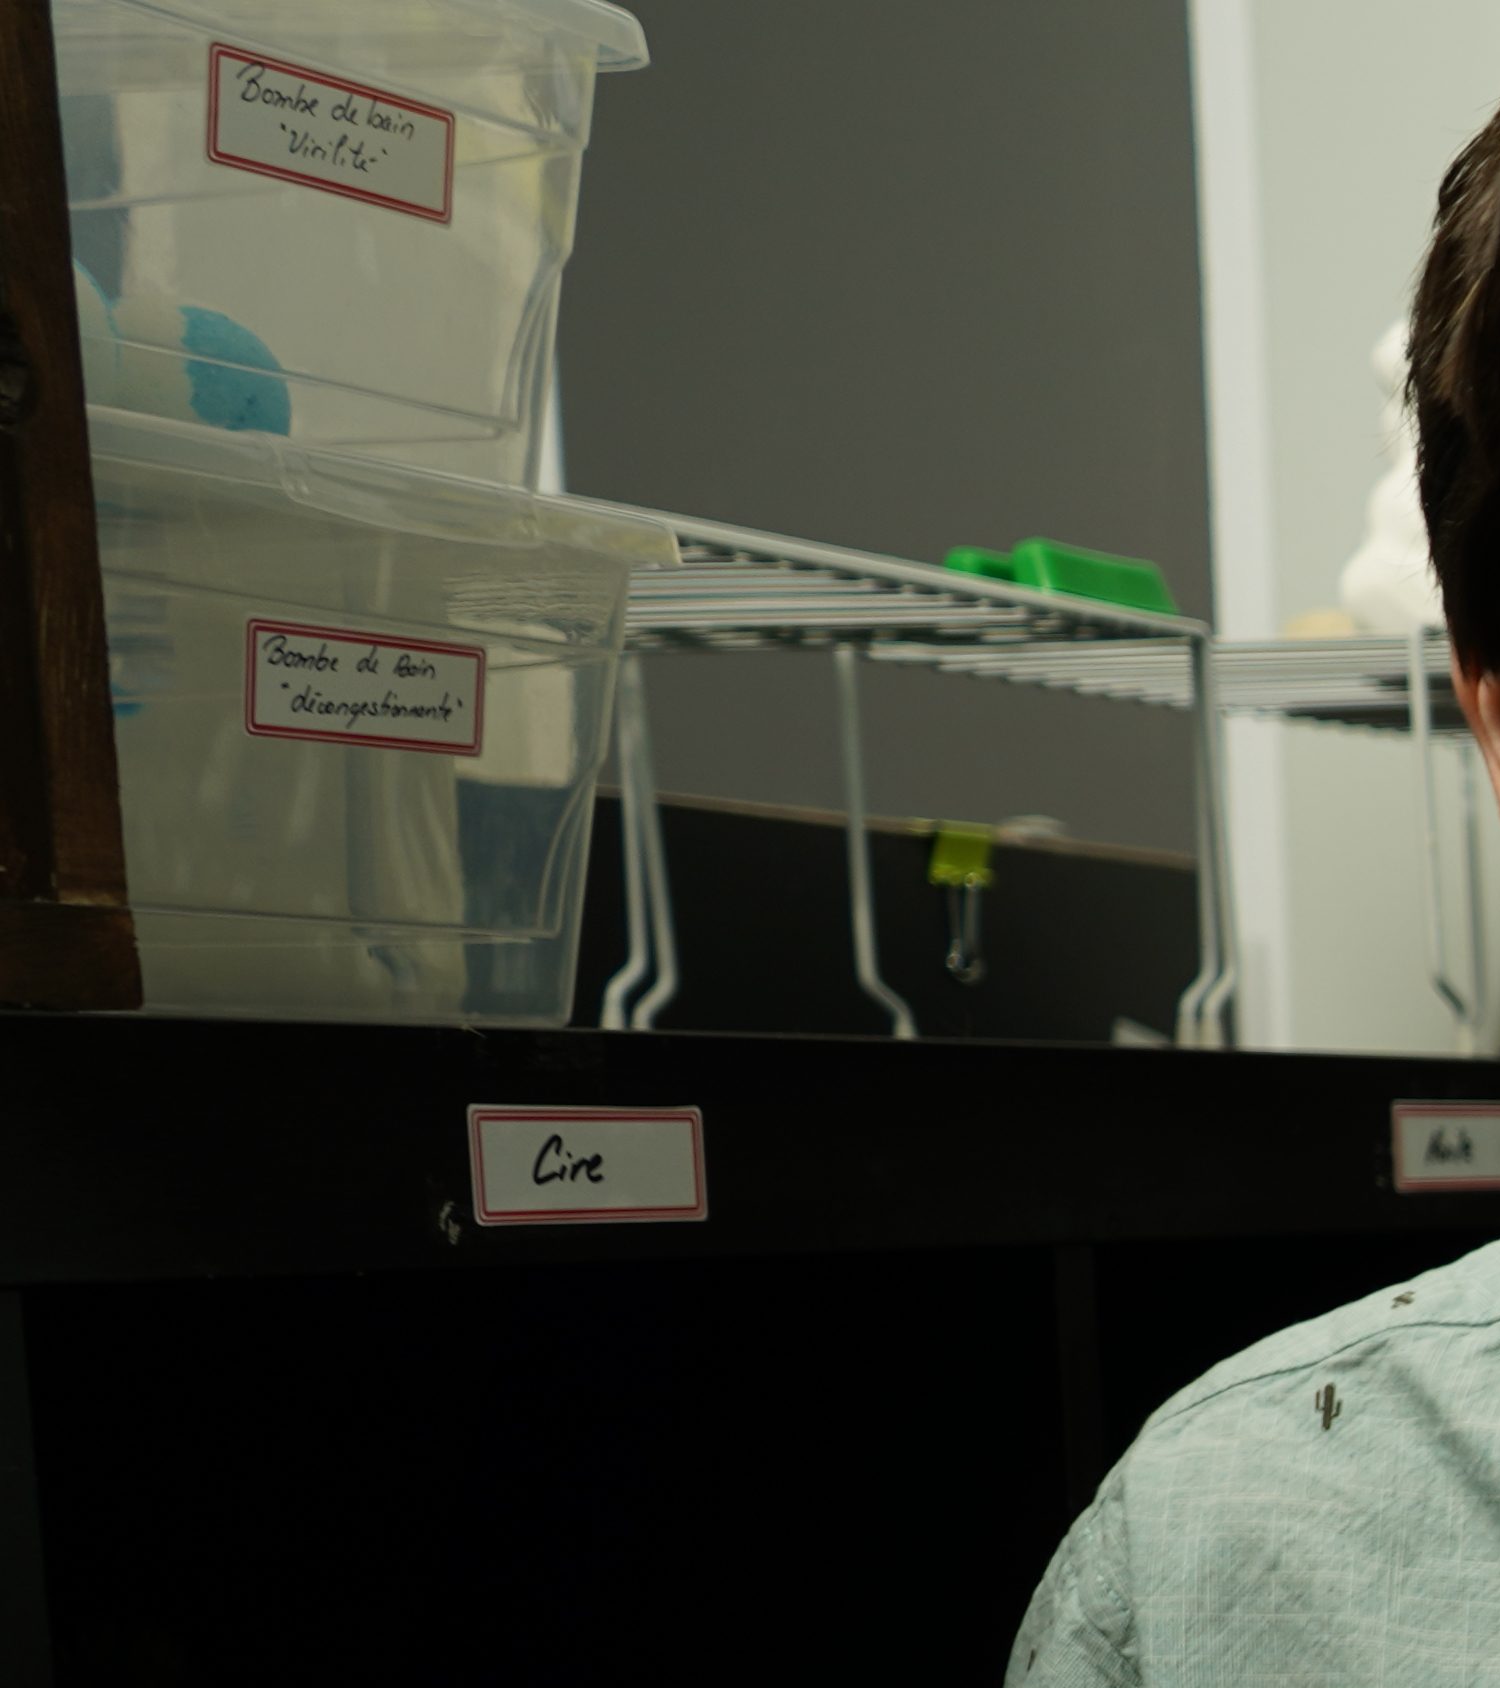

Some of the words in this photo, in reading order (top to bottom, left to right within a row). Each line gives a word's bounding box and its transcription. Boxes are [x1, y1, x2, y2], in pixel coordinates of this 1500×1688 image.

[237, 63, 318, 116] Bombe
[331, 93, 358, 125] de
[262, 635, 339, 672] Bombe
[356, 645, 379, 674] de
[533, 1134, 605, 1185] Cire
